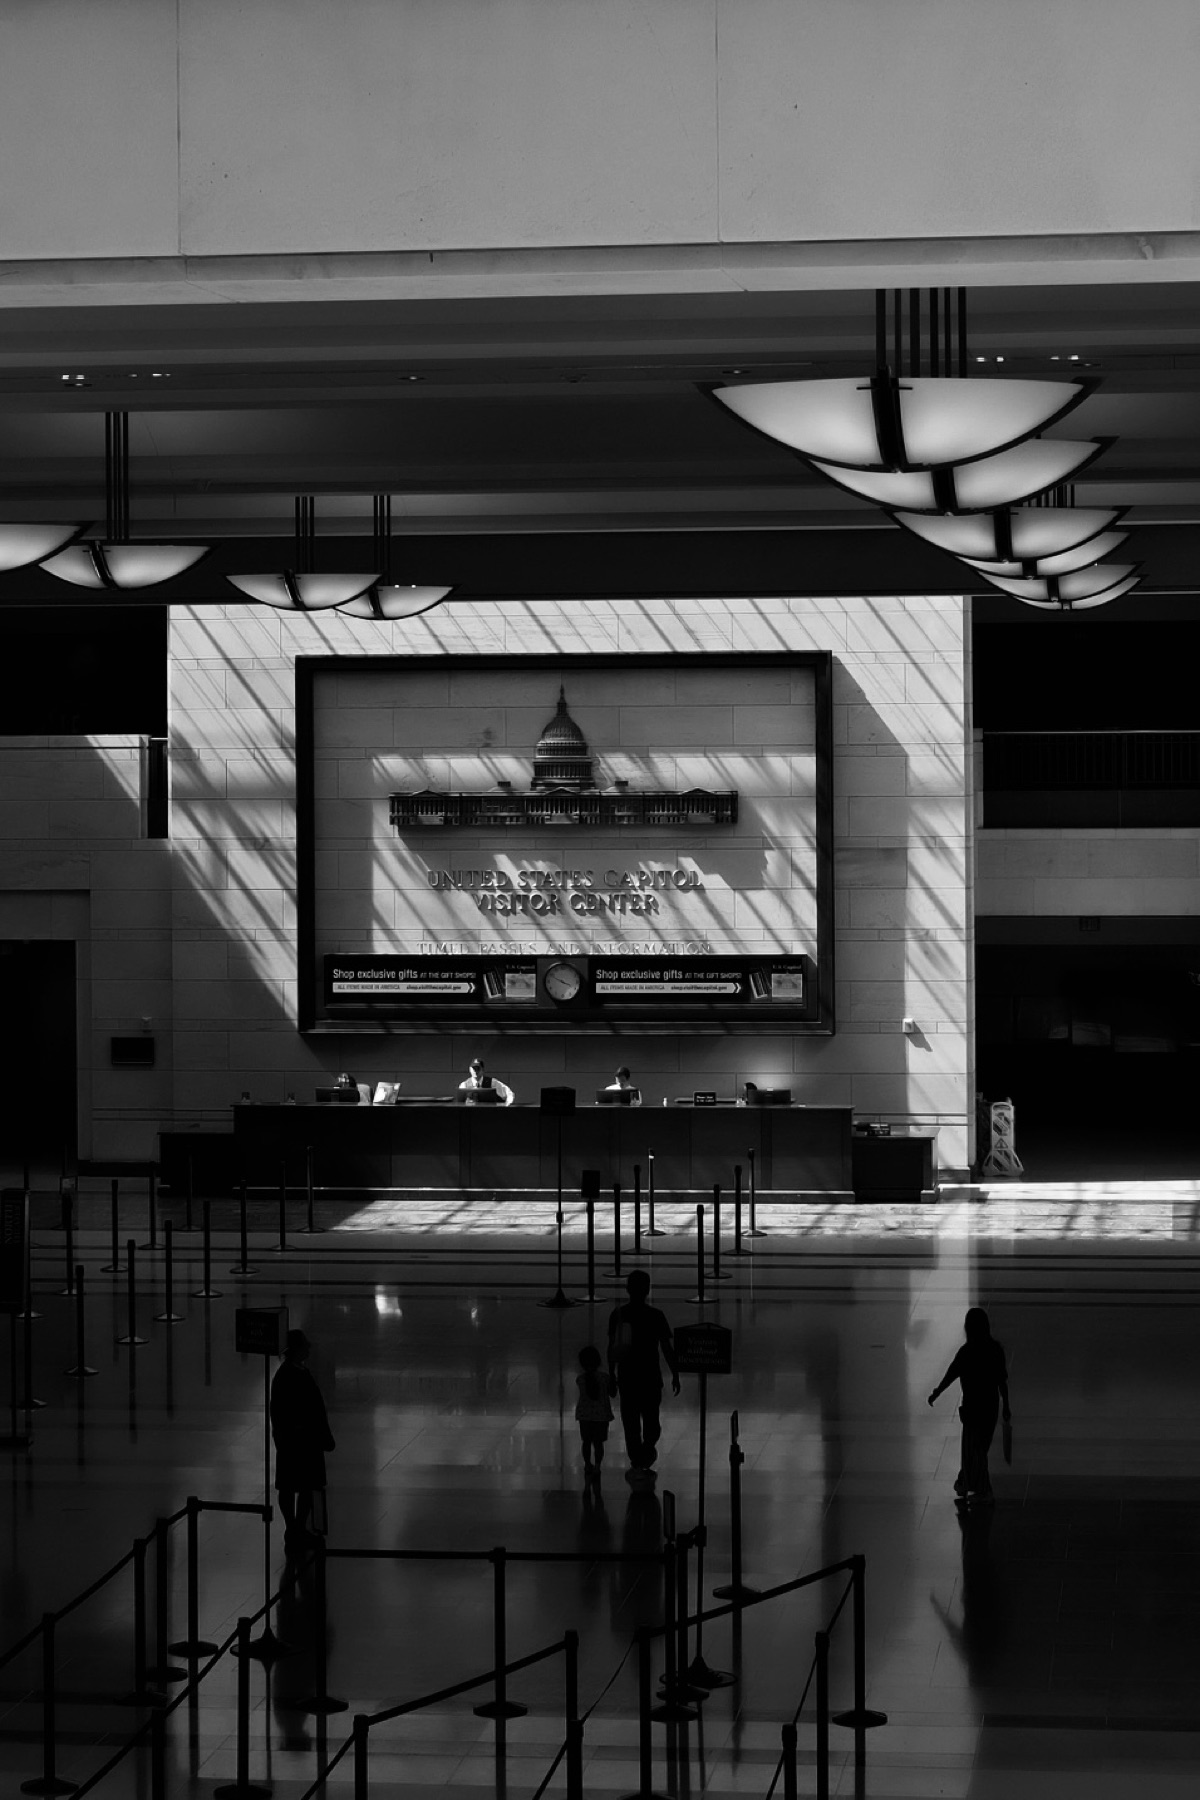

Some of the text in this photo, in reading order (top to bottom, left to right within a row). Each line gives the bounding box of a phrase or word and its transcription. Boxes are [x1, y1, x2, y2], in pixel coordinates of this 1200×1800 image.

[427, 869, 703, 888] UNITED STATES CAPITOL
[470, 892, 659, 911] VISITOR CENTER
[417, 942, 711, 955] TIMED PASSES AND INFORMATION
[333, 968, 419, 981] Shop exclusive gifts
[595, 968, 683, 981] Shop exclusive gifts
